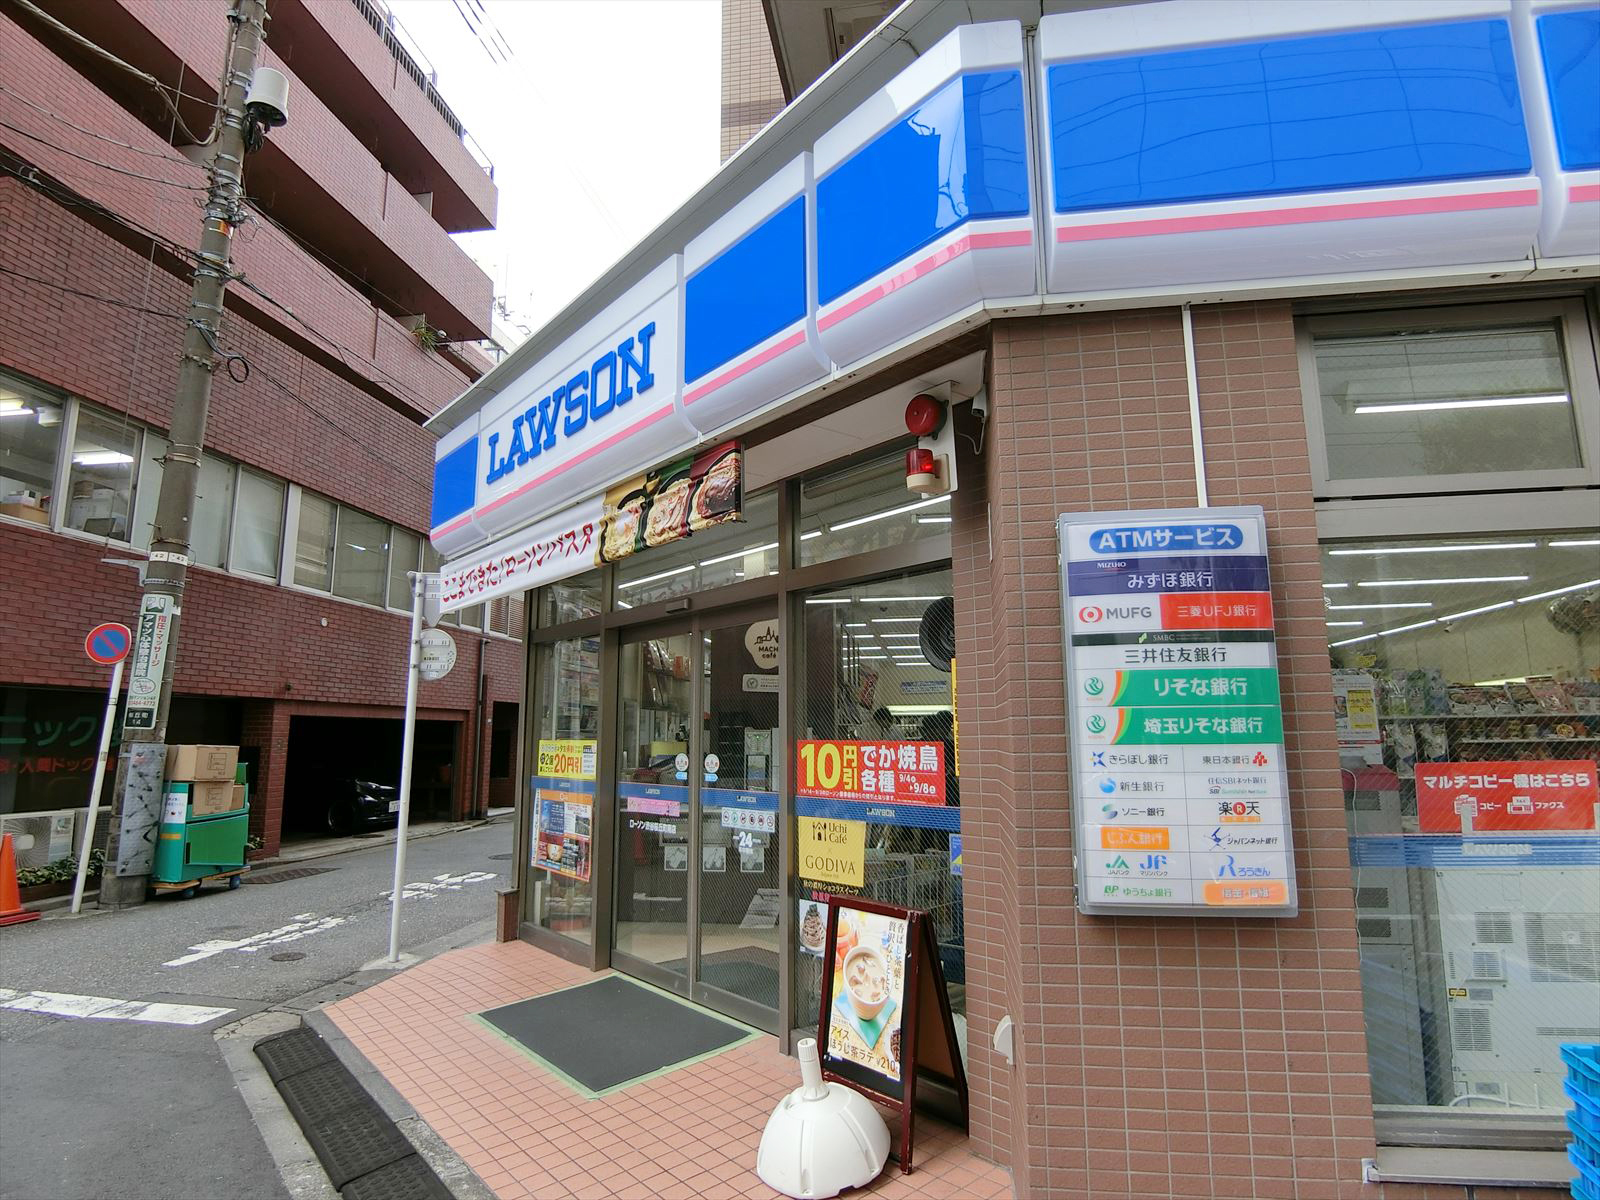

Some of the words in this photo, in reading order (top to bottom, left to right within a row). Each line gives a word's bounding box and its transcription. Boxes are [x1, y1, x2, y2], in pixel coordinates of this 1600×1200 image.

[487, 321, 656, 485] LAWSON
[1099, 527, 1237, 550] ATMサービス
[1097, 561, 1127, 569] MIZUHO
[1127, 571, 1213, 588] みずほ銀行
[1106, 607, 1152, 619] MUFG
[1177, 604, 1257, 618] 三菱UFJ銀行
[1153, 633, 1175, 642] SMBC
[1124, 648, 1227, 664] 三井住友銀行
[1154, 677, 1248, 696] りそな銀行
[1144, 717, 1263, 735] 埼玉りそな銀行
[860, 744, 938, 771] でか焼鳥
[1109, 754, 1168, 765] きらぼし銀行
[1202, 755, 1250, 765] 東日本銀行
[800, 743, 841, 789] 10
[861, 769, 896, 793] 各種
[1120, 781, 1165, 792] 新生銀行
[1422, 773, 1591, 789] マルチコピー機はこちら
[866, 808, 896, 817] LAWSON
[1121, 807, 1165, 817] ソニー銀行
[1479, 802, 1502, 810] コピー
[828, 822, 848, 834] Uchi
[828, 832, 848, 845] Café
[1227, 836, 1278, 845] ジャパンネット銀行
[805, 854, 856, 876] GODIVA
[1238, 867, 1271, 877] ろうきん
[1123, 887, 1172, 897] ゆうちょ銀行
[831, 1024, 850, 1041] アイス
[829, 1037, 874, 1063] ほうじ茶ラテ
